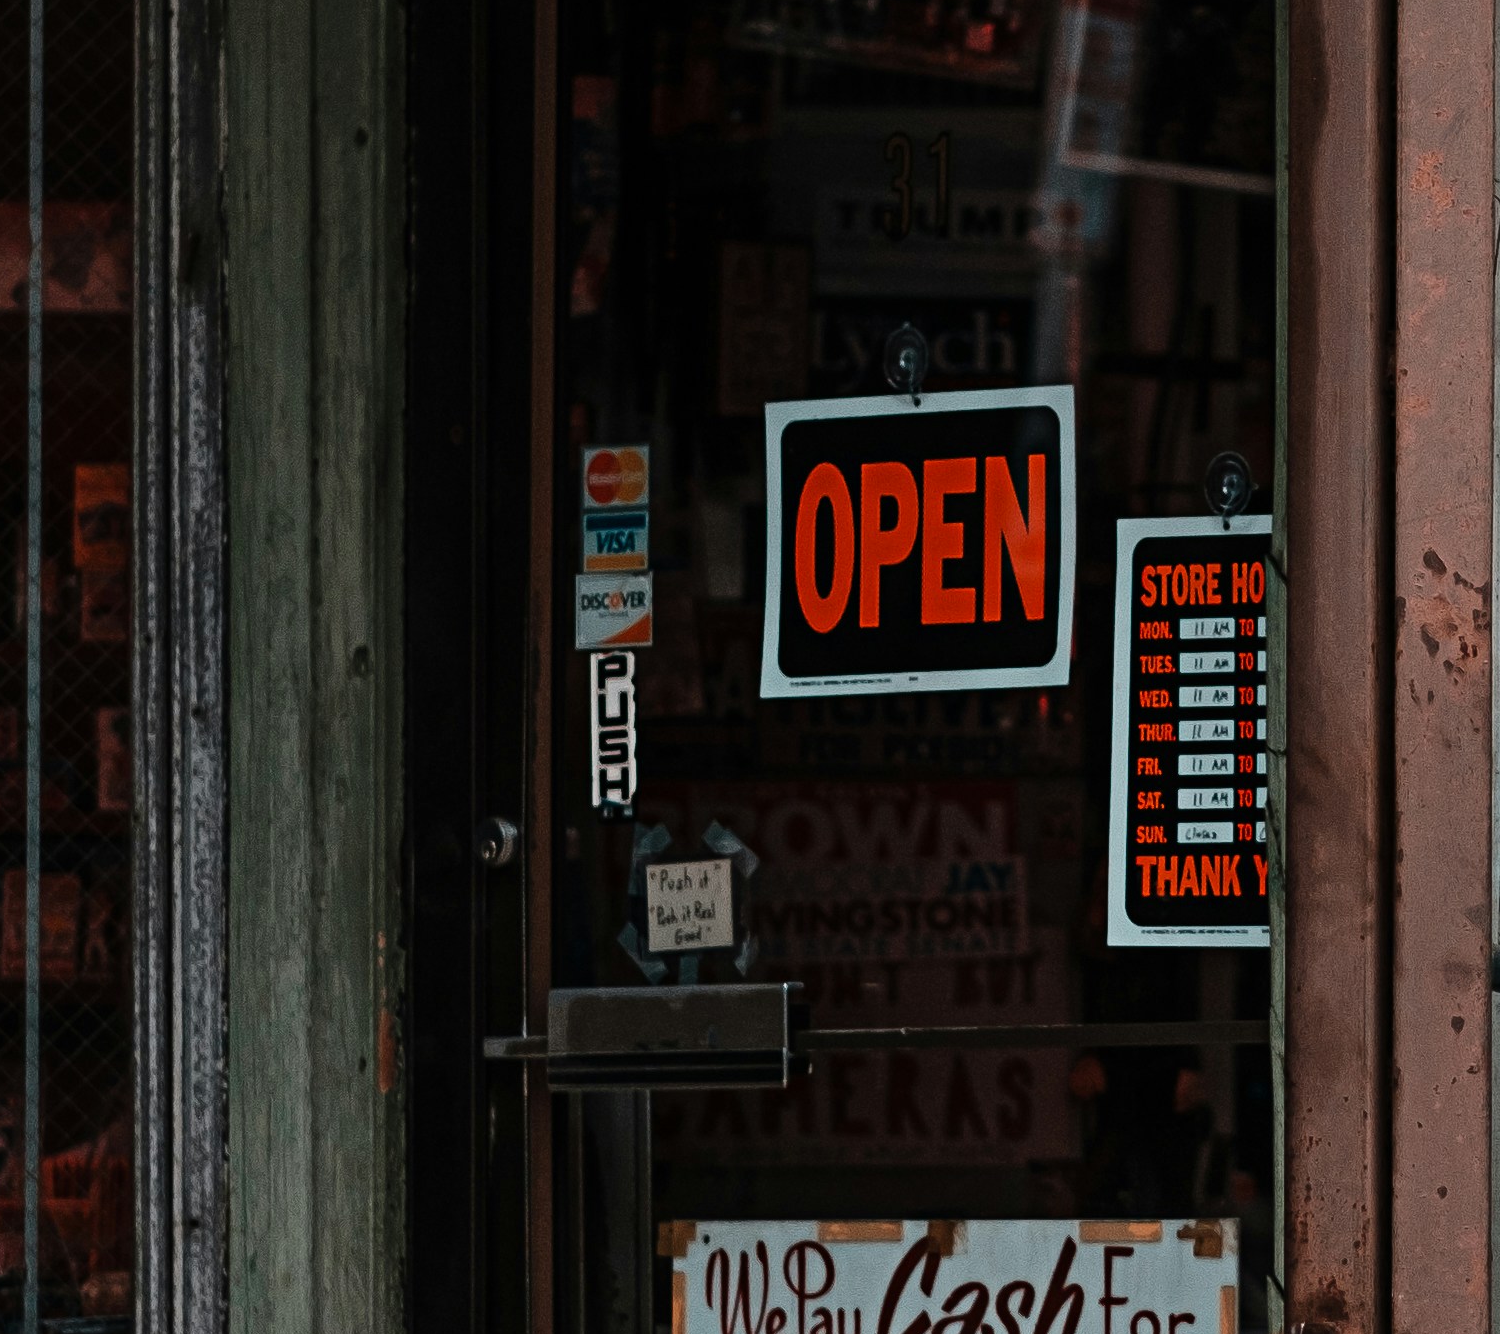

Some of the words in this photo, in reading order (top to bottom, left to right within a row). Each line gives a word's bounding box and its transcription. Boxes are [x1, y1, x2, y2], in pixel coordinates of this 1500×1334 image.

[884, 130, 950, 241] 31
[596, 531, 636, 554] VISA
[794, 453, 1047, 634] OPEN
[1140, 563, 1223, 608] STORE
[581, 591, 646, 612] DISCOVER
[1139, 620, 1173, 640] MON.
[1238, 618, 1256, 637] TO
[1139, 655, 1176, 674] TUES.
[1238, 652, 1256, 671] TO
[1138, 690, 1174, 708] WED.
[1238, 686, 1256, 705] TO
[597, 654, 630, 801] PUSH
[1138, 723, 1177, 742] THUR.
[1238, 721, 1256, 740] TO
[1136, 757, 1163, 775] FRI.
[1237, 755, 1255, 773] TO
[1136, 791, 1165, 810] SAT.
[1237, 789, 1255, 808] TO
[1136, 825, 1168, 844] SUN.
[1237, 823, 1255, 842] TO
[945, 862, 1014, 893] JAY
[1136, 854, 1241, 898] THANK
